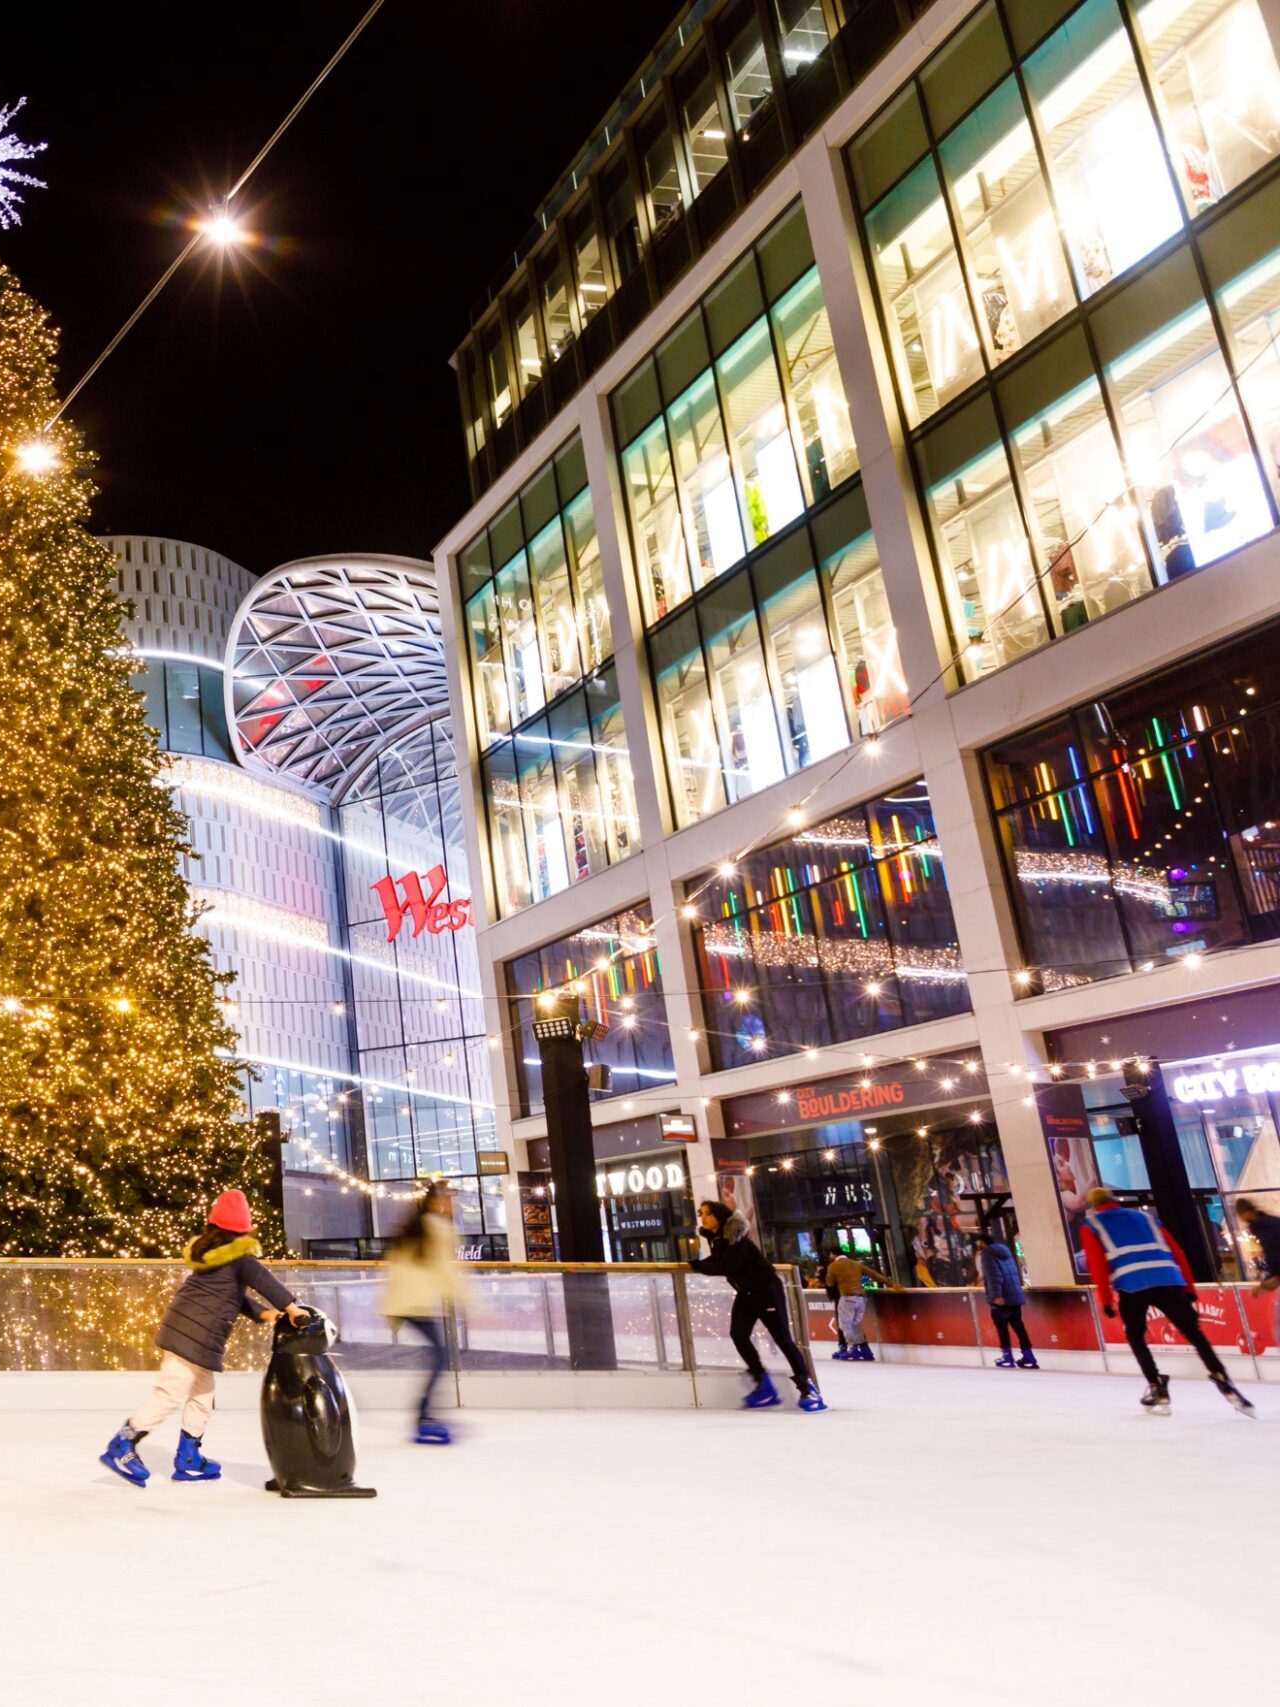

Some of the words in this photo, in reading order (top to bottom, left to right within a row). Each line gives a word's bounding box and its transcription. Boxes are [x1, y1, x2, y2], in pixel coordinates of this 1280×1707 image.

[798, 1081, 905, 1120] BOULDERING
[1174, 1068, 1237, 1104] CITY
[455, 1244, 483, 1260] field
